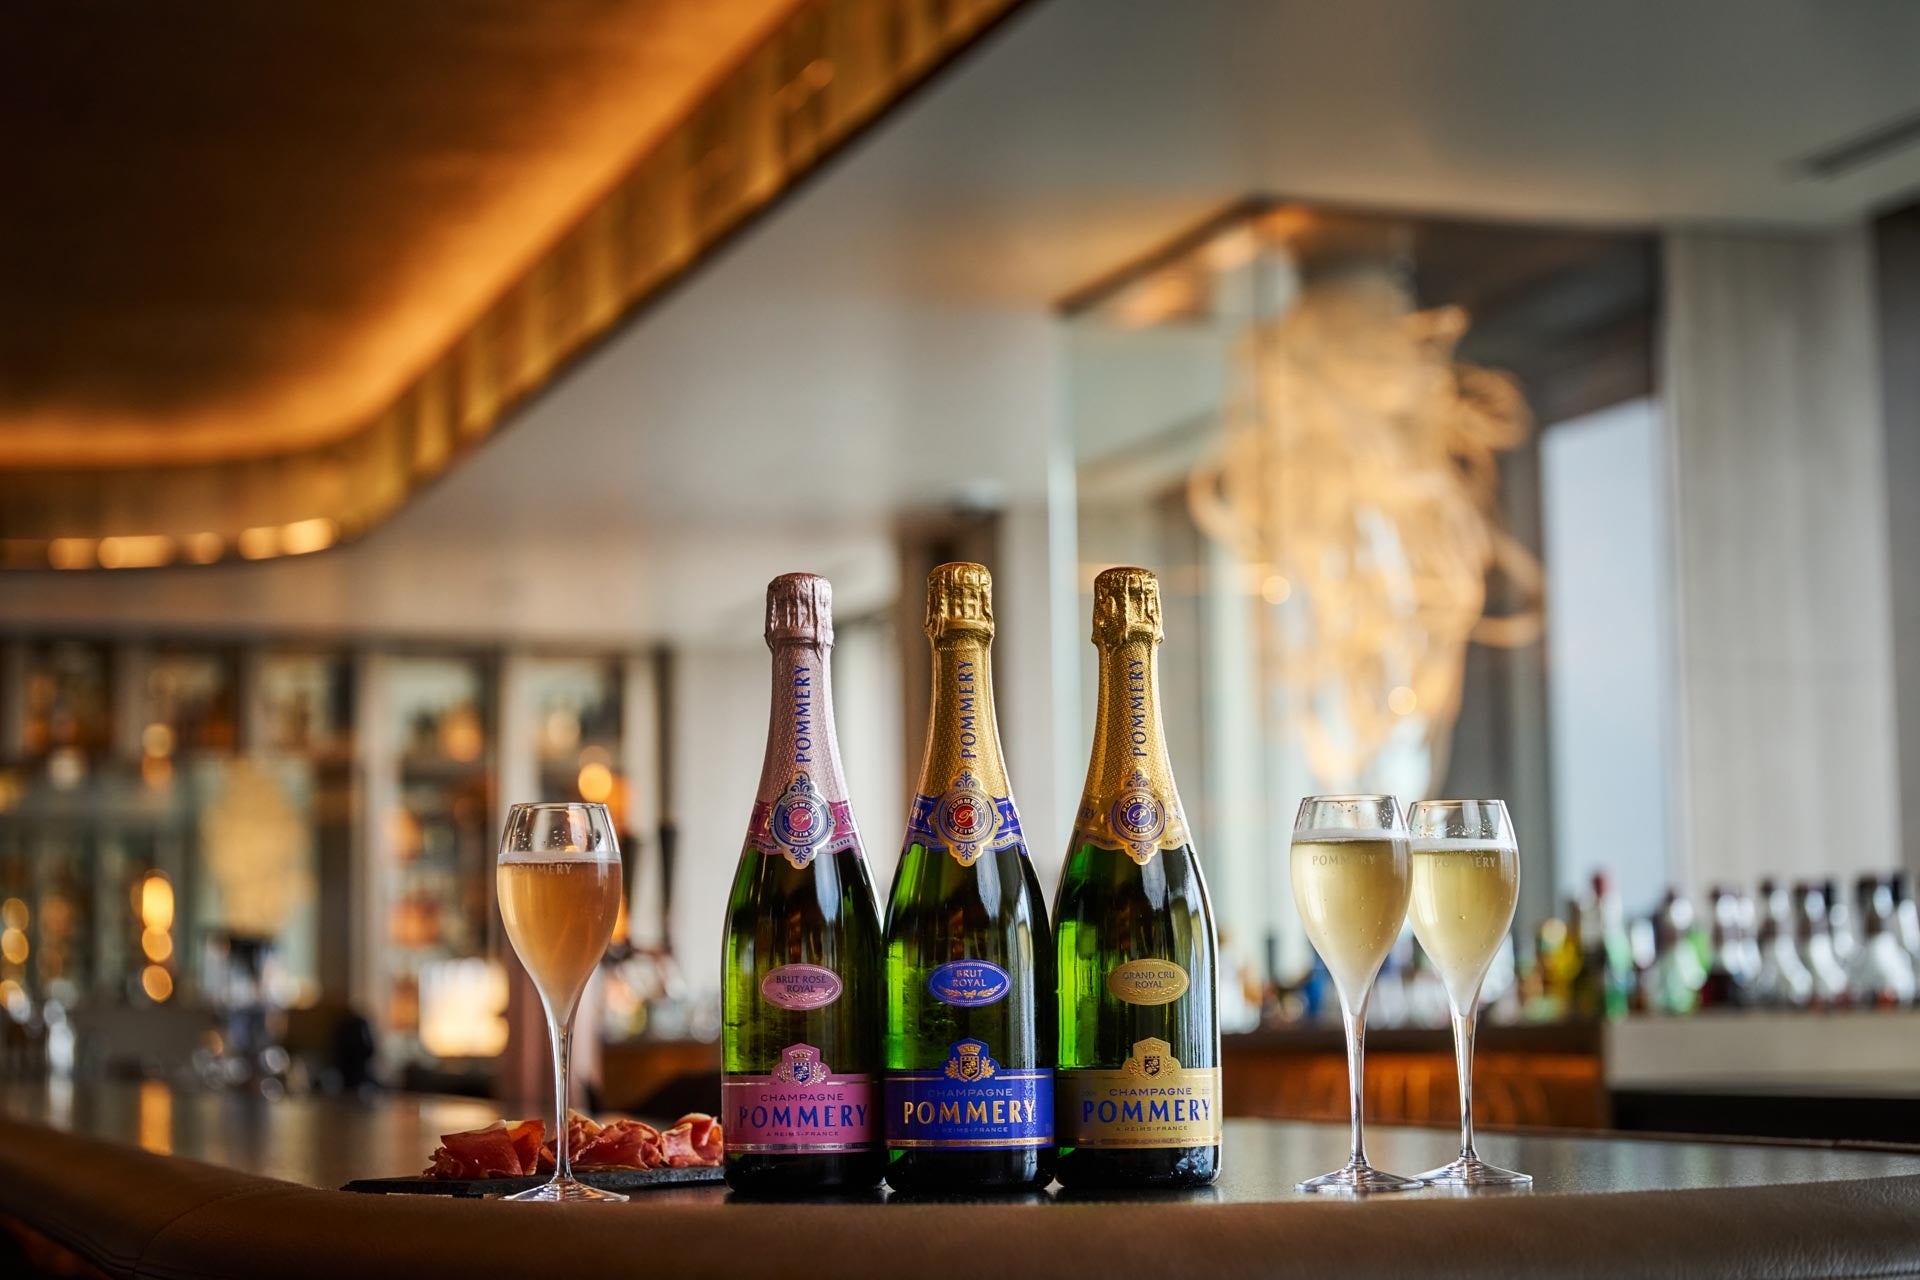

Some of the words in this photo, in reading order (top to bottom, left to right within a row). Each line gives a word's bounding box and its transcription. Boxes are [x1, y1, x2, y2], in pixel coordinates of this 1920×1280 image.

[958, 660, 976, 759] POMMERY
[1129, 658, 1147, 757] POMMERY
[794, 665, 811, 763] POMMERY
[949, 798, 984, 813] POMMERY
[1122, 797, 1156, 813] POMMERY
[956, 969, 983, 977] BRUT
[1123, 971, 1155, 979] GRAND
[1158, 971, 1175, 979] CRU
[776, 975, 800, 984] BRUT
[952, 979, 987, 987] ROYAL
[786, 984, 815, 993] ROYAL
[760, 1093, 844, 1102] CHAMPAGNE
[927, 1088, 1013, 1097] CHAMPAGNE
[1109, 1087, 1192, 1097] CHAMPAGNE
[739, 1104, 868, 1128] POMMERY
[903, 1100, 1036, 1124] POMMERY
[1083, 1099, 1211, 1123] POMMERY
